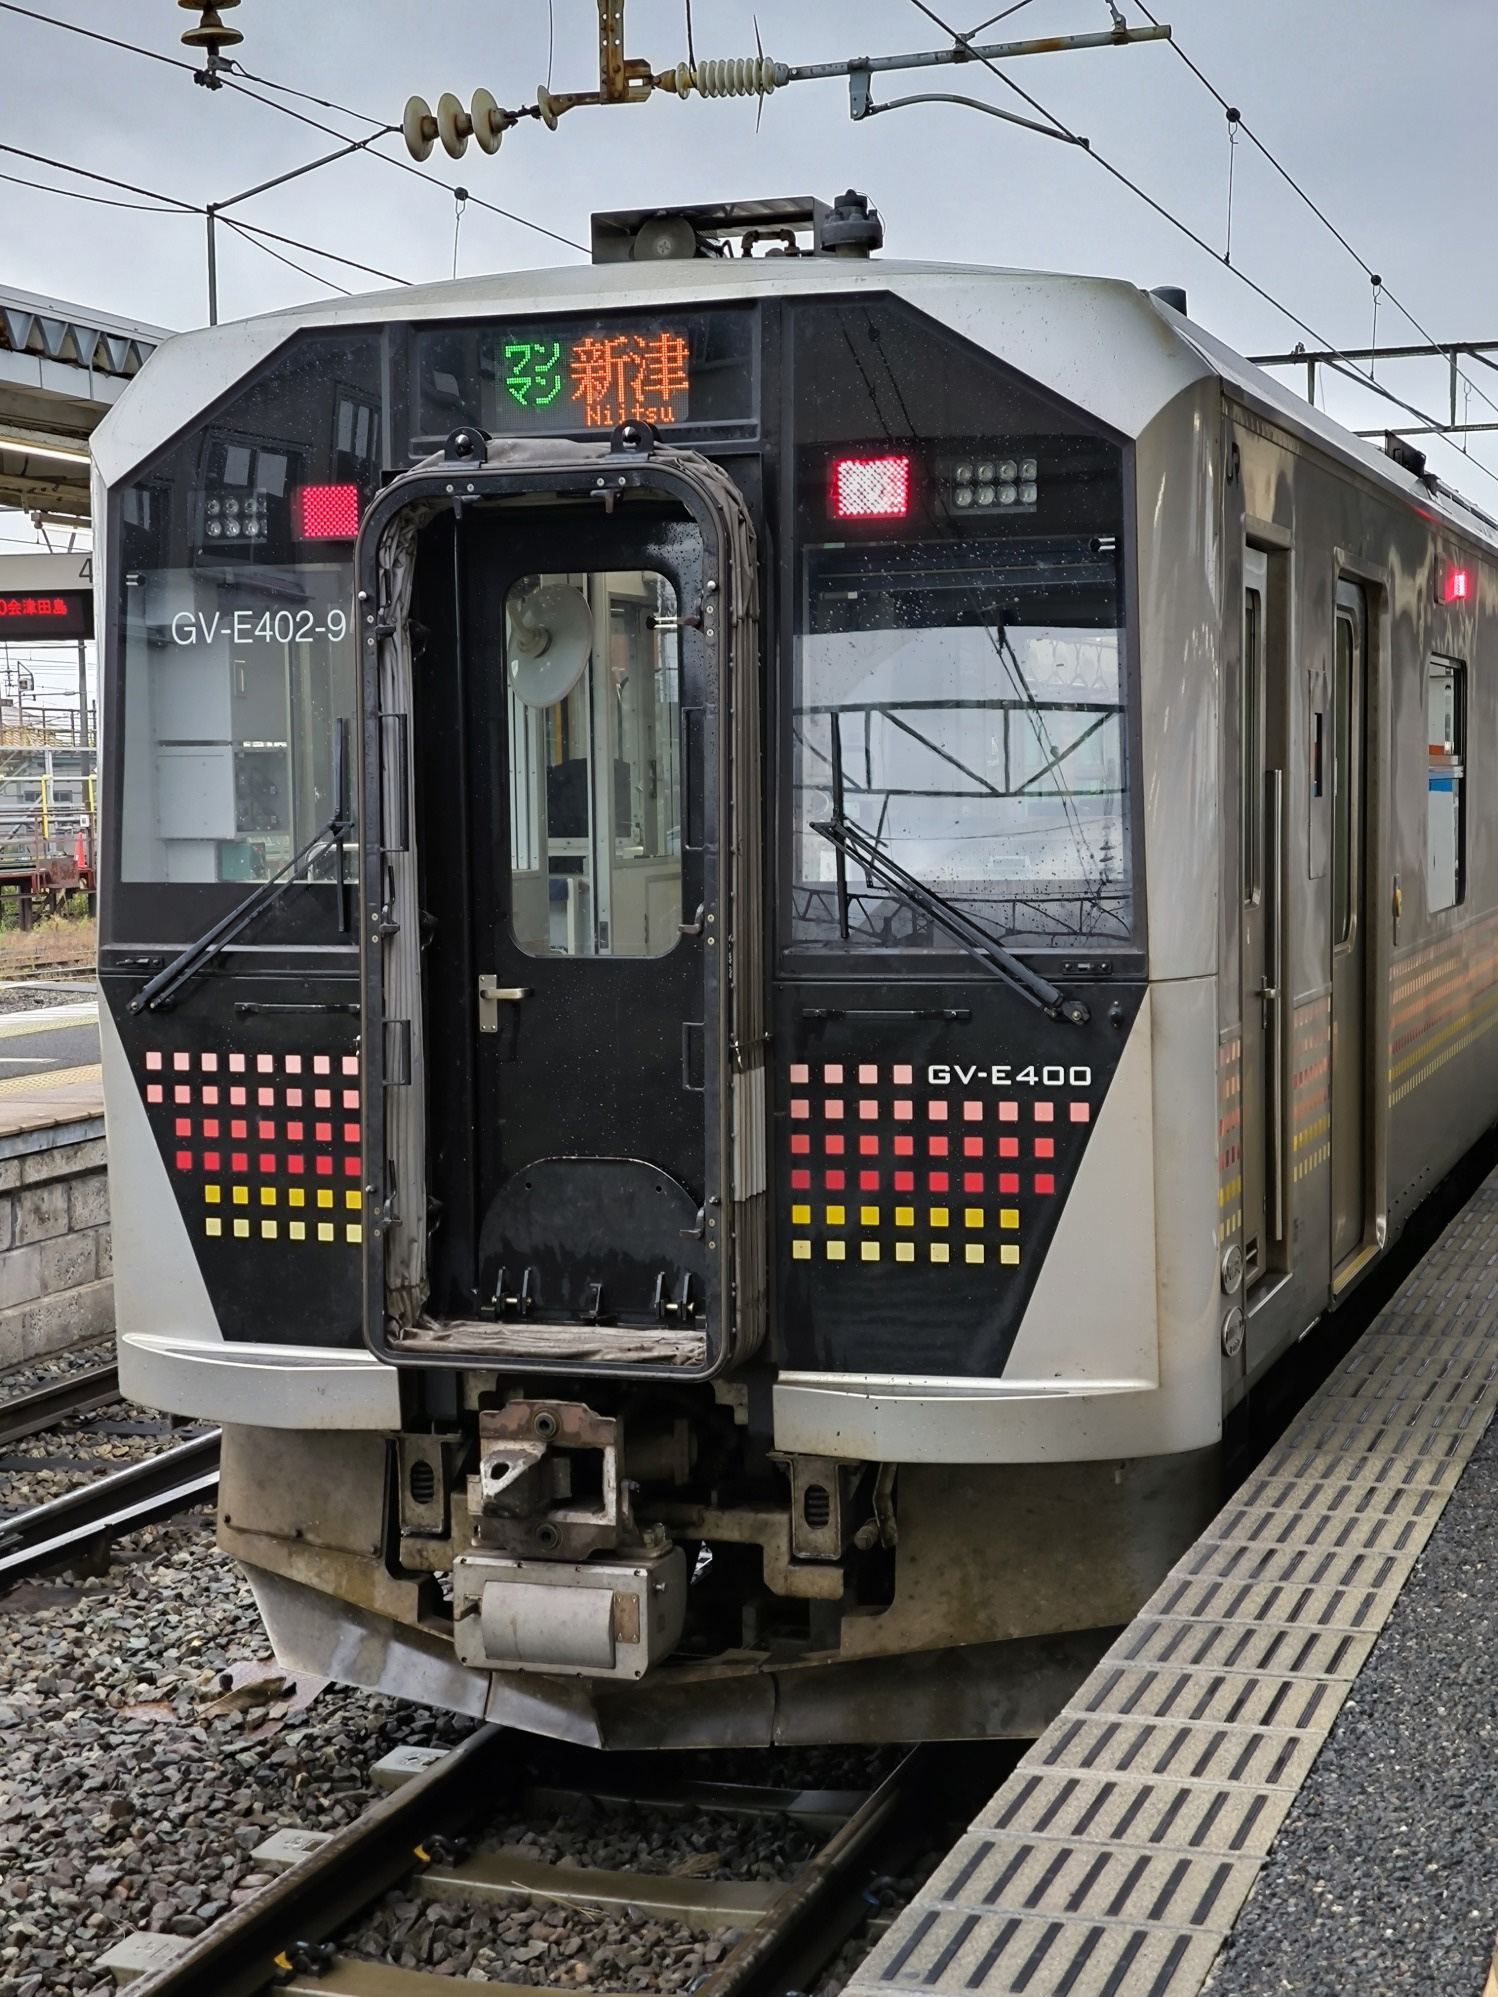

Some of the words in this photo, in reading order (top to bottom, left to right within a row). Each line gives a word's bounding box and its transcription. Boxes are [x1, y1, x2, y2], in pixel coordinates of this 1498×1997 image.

[570, 333, 689, 404] 新津
[585, 403, 675, 426] Niitsu
[78, 557, 94, 584] 4
[171, 609, 347, 645] GV-E402-9
[928, 1065, 1092, 1086] GV-E400
